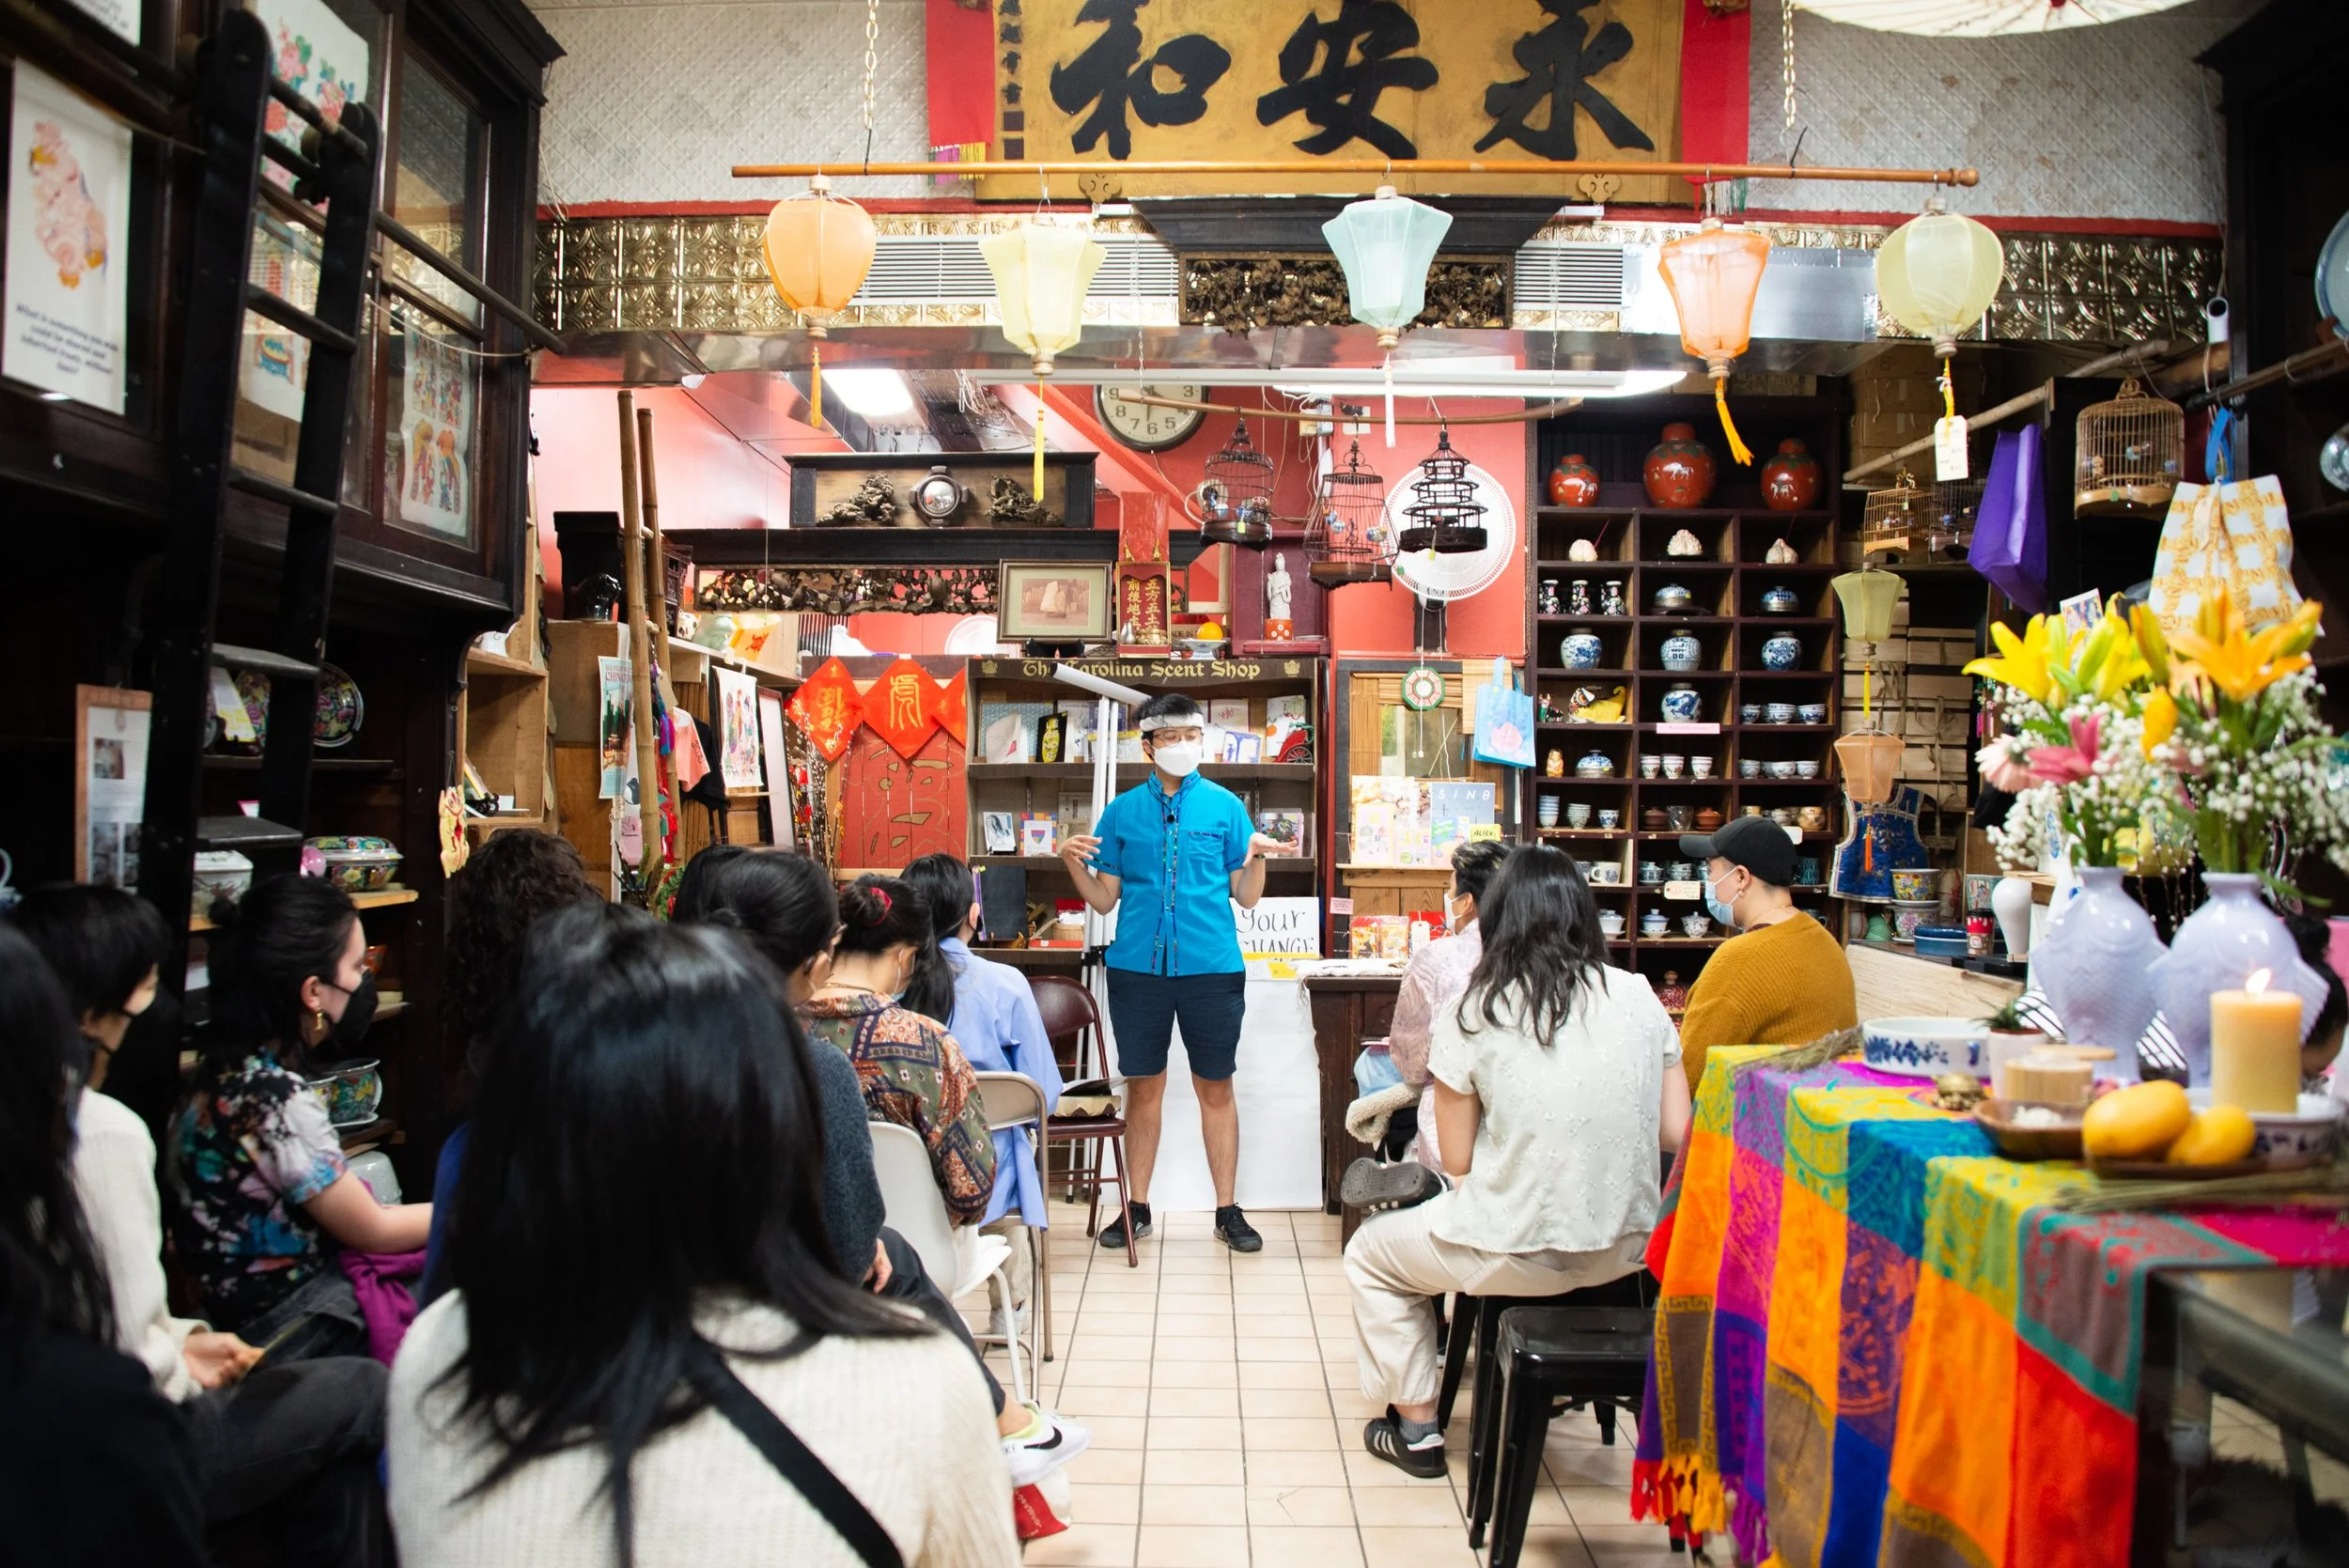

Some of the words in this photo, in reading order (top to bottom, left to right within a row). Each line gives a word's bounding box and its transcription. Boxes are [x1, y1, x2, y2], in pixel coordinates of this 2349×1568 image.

[1109, 387, 1119, 400] 9
[1183, 385, 1194, 397] 3
[1115, 405, 1127, 418] 8
[1130, 418, 1140, 430] 7
[1147, 422, 1158, 435] 6
[1165, 416, 1176, 429] 5
[1022, 660, 1050, 677] Th
[1150, 660, 1205, 678] Scent
[1210, 660, 1261, 679] Shop
